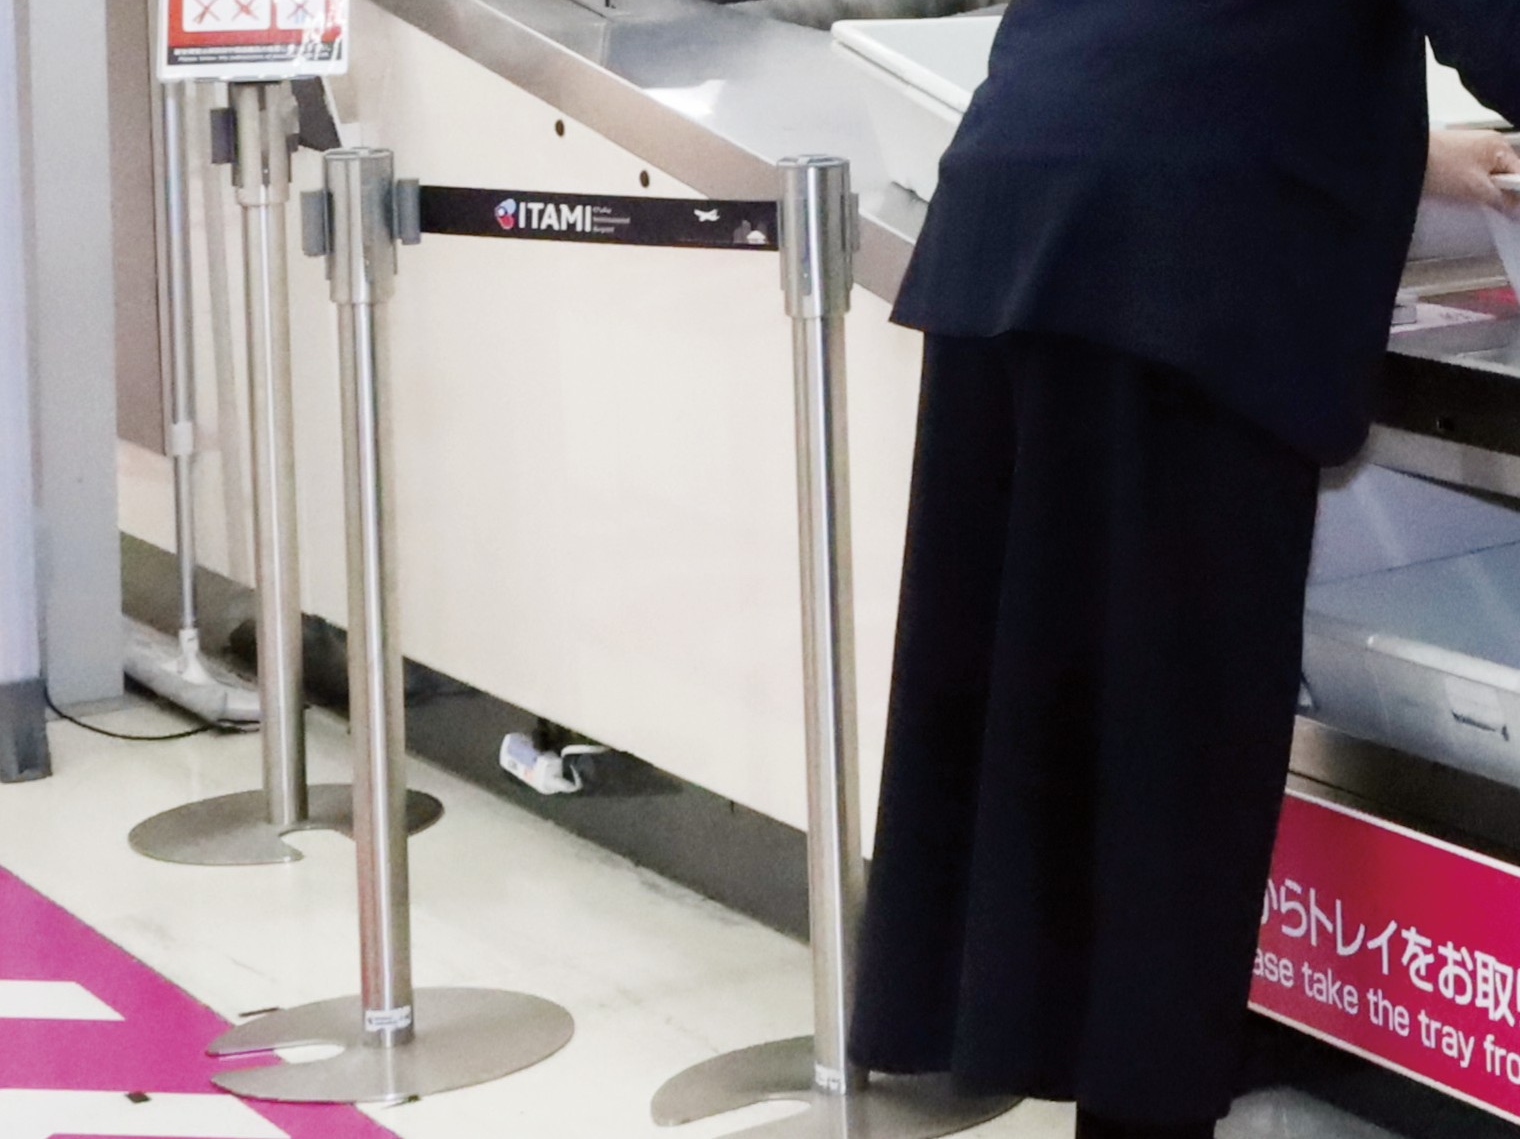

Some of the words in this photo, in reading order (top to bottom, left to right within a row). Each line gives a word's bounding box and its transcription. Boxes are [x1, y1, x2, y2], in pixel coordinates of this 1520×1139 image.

[518, 201, 592, 232] ITAMI
[1302, 961, 1358, 1016] take
[1367, 986, 1410, 1037] the
[1417, 1012, 1475, 1068] tray
